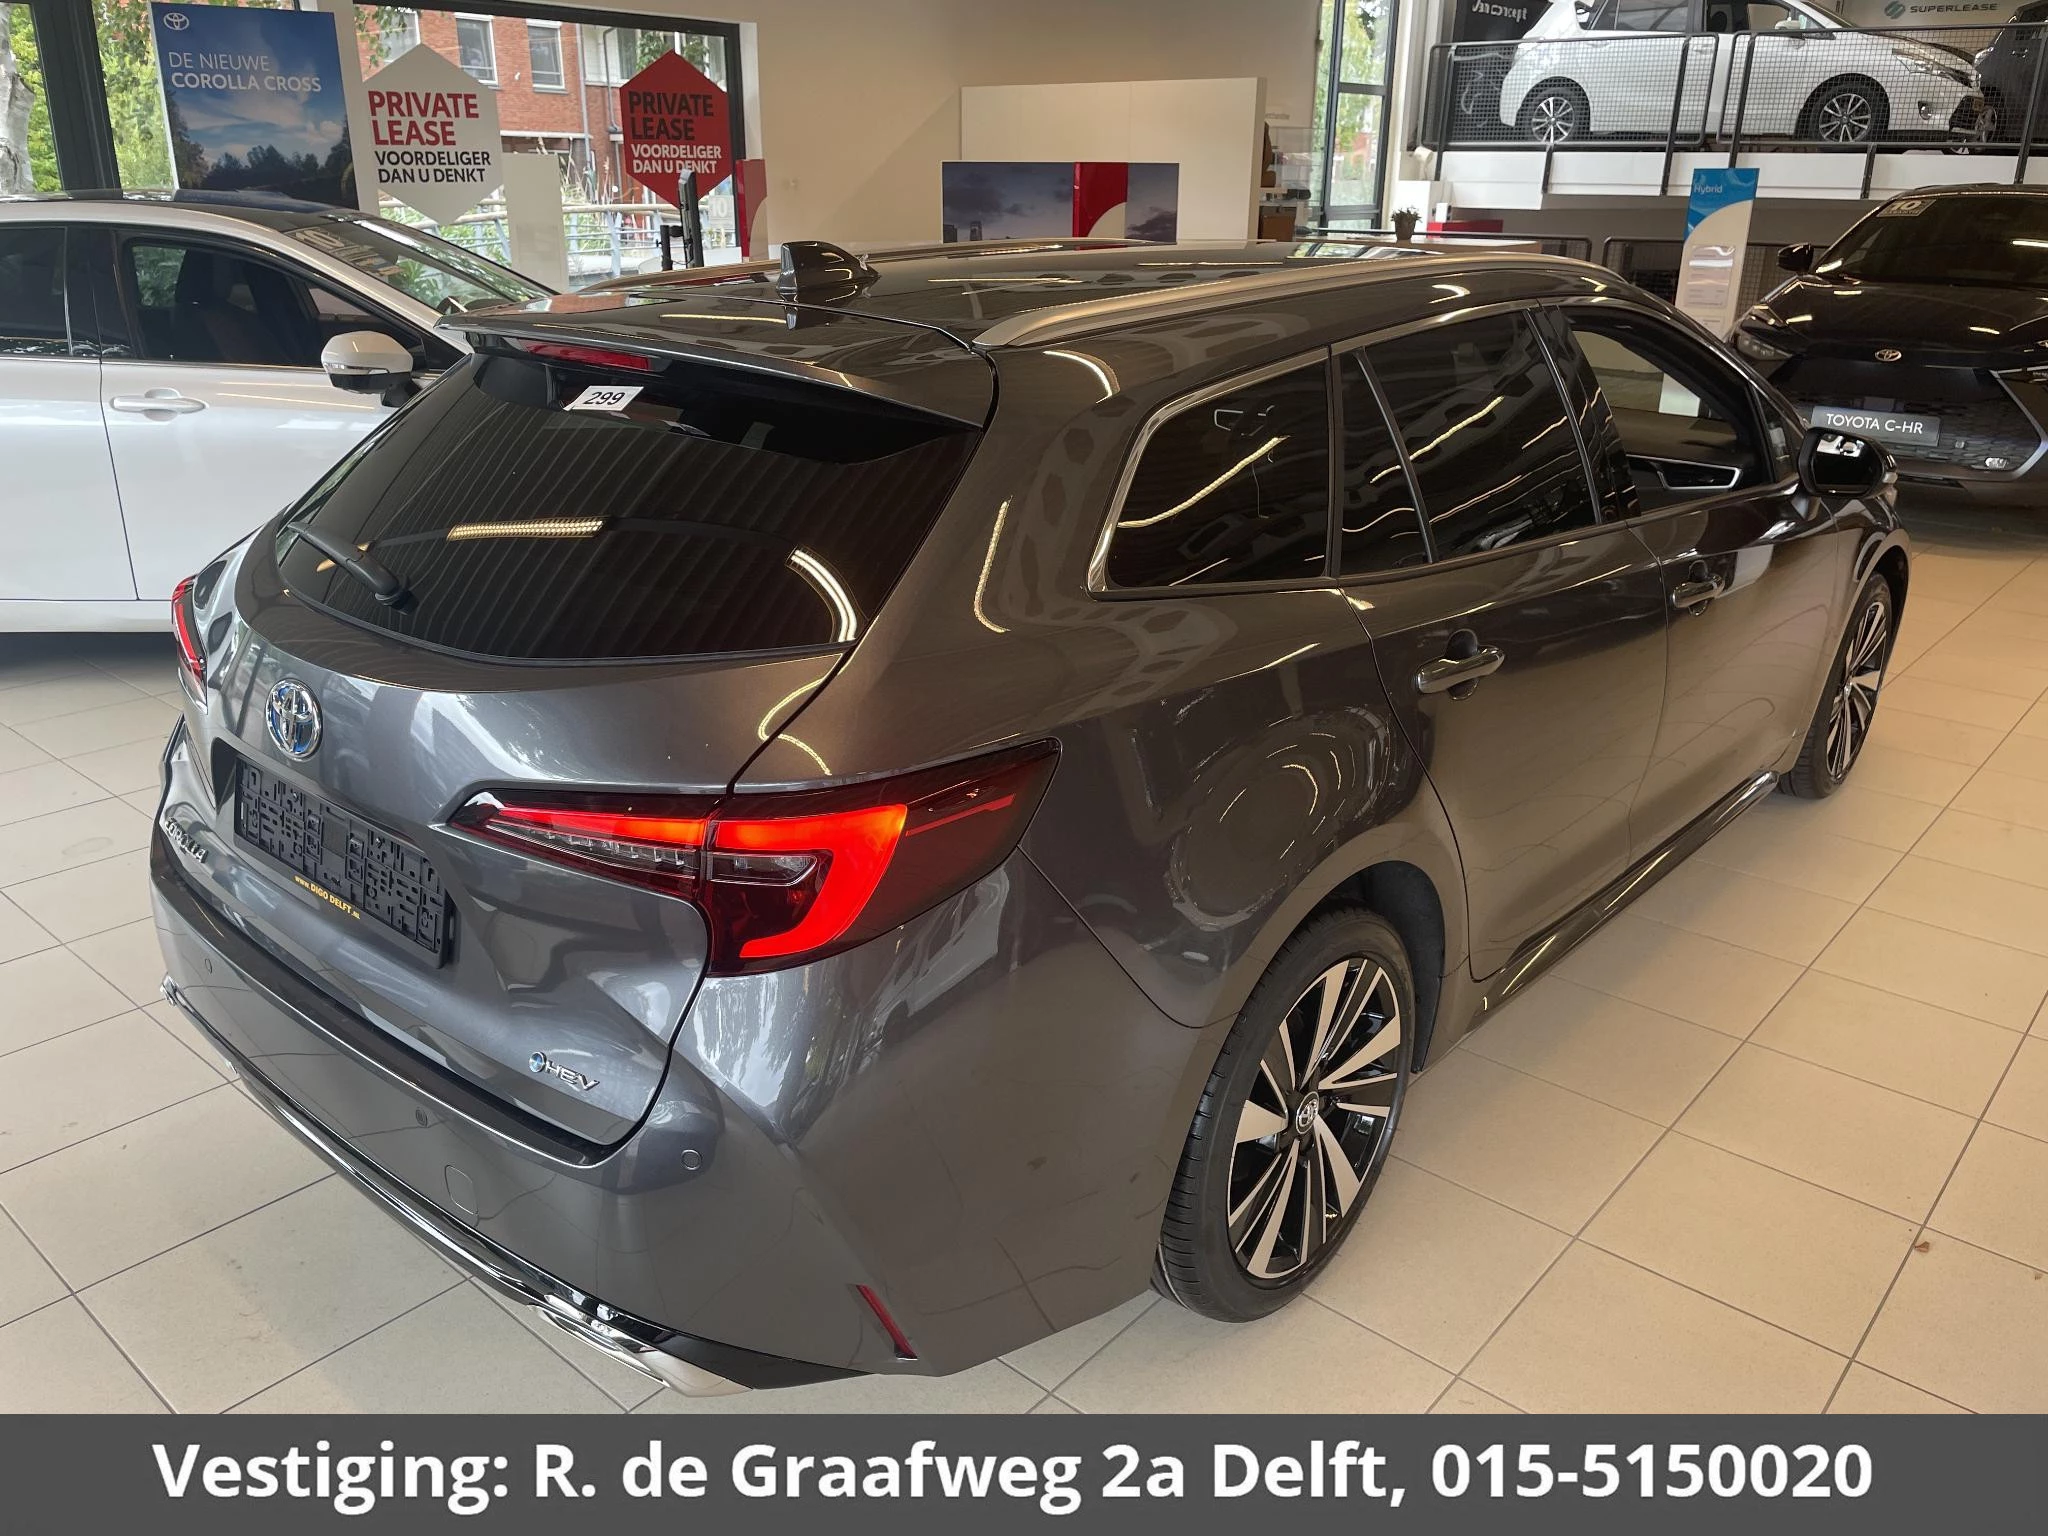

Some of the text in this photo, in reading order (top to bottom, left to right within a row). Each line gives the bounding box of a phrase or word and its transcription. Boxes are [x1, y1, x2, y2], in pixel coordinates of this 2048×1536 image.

[1910, 3, 1998, 13] SUPERLEASE
[168, 51, 271, 72] DE NIEUWE
[171, 72, 322, 92] COROLLA CROSS
[367, 90, 479, 119] PRIVATE
[628, 91, 714, 117] PRIVATE
[371, 120, 457, 146] LEASE
[631, 117, 695, 140] LEASE
[374, 150, 492, 166] VOORDELIGER
[630, 143, 722, 159] VOORDELIGER
[378, 168, 486, 183] DAN U DENKT
[632, 159, 717, 174] DAN U DENKT
[1693, 184, 1723, 194] Hybrid
[583, 391, 626, 406] 299
[1826, 413, 1923, 434] TOYOTA C-HR
[546, 1060, 600, 1091] HEV
